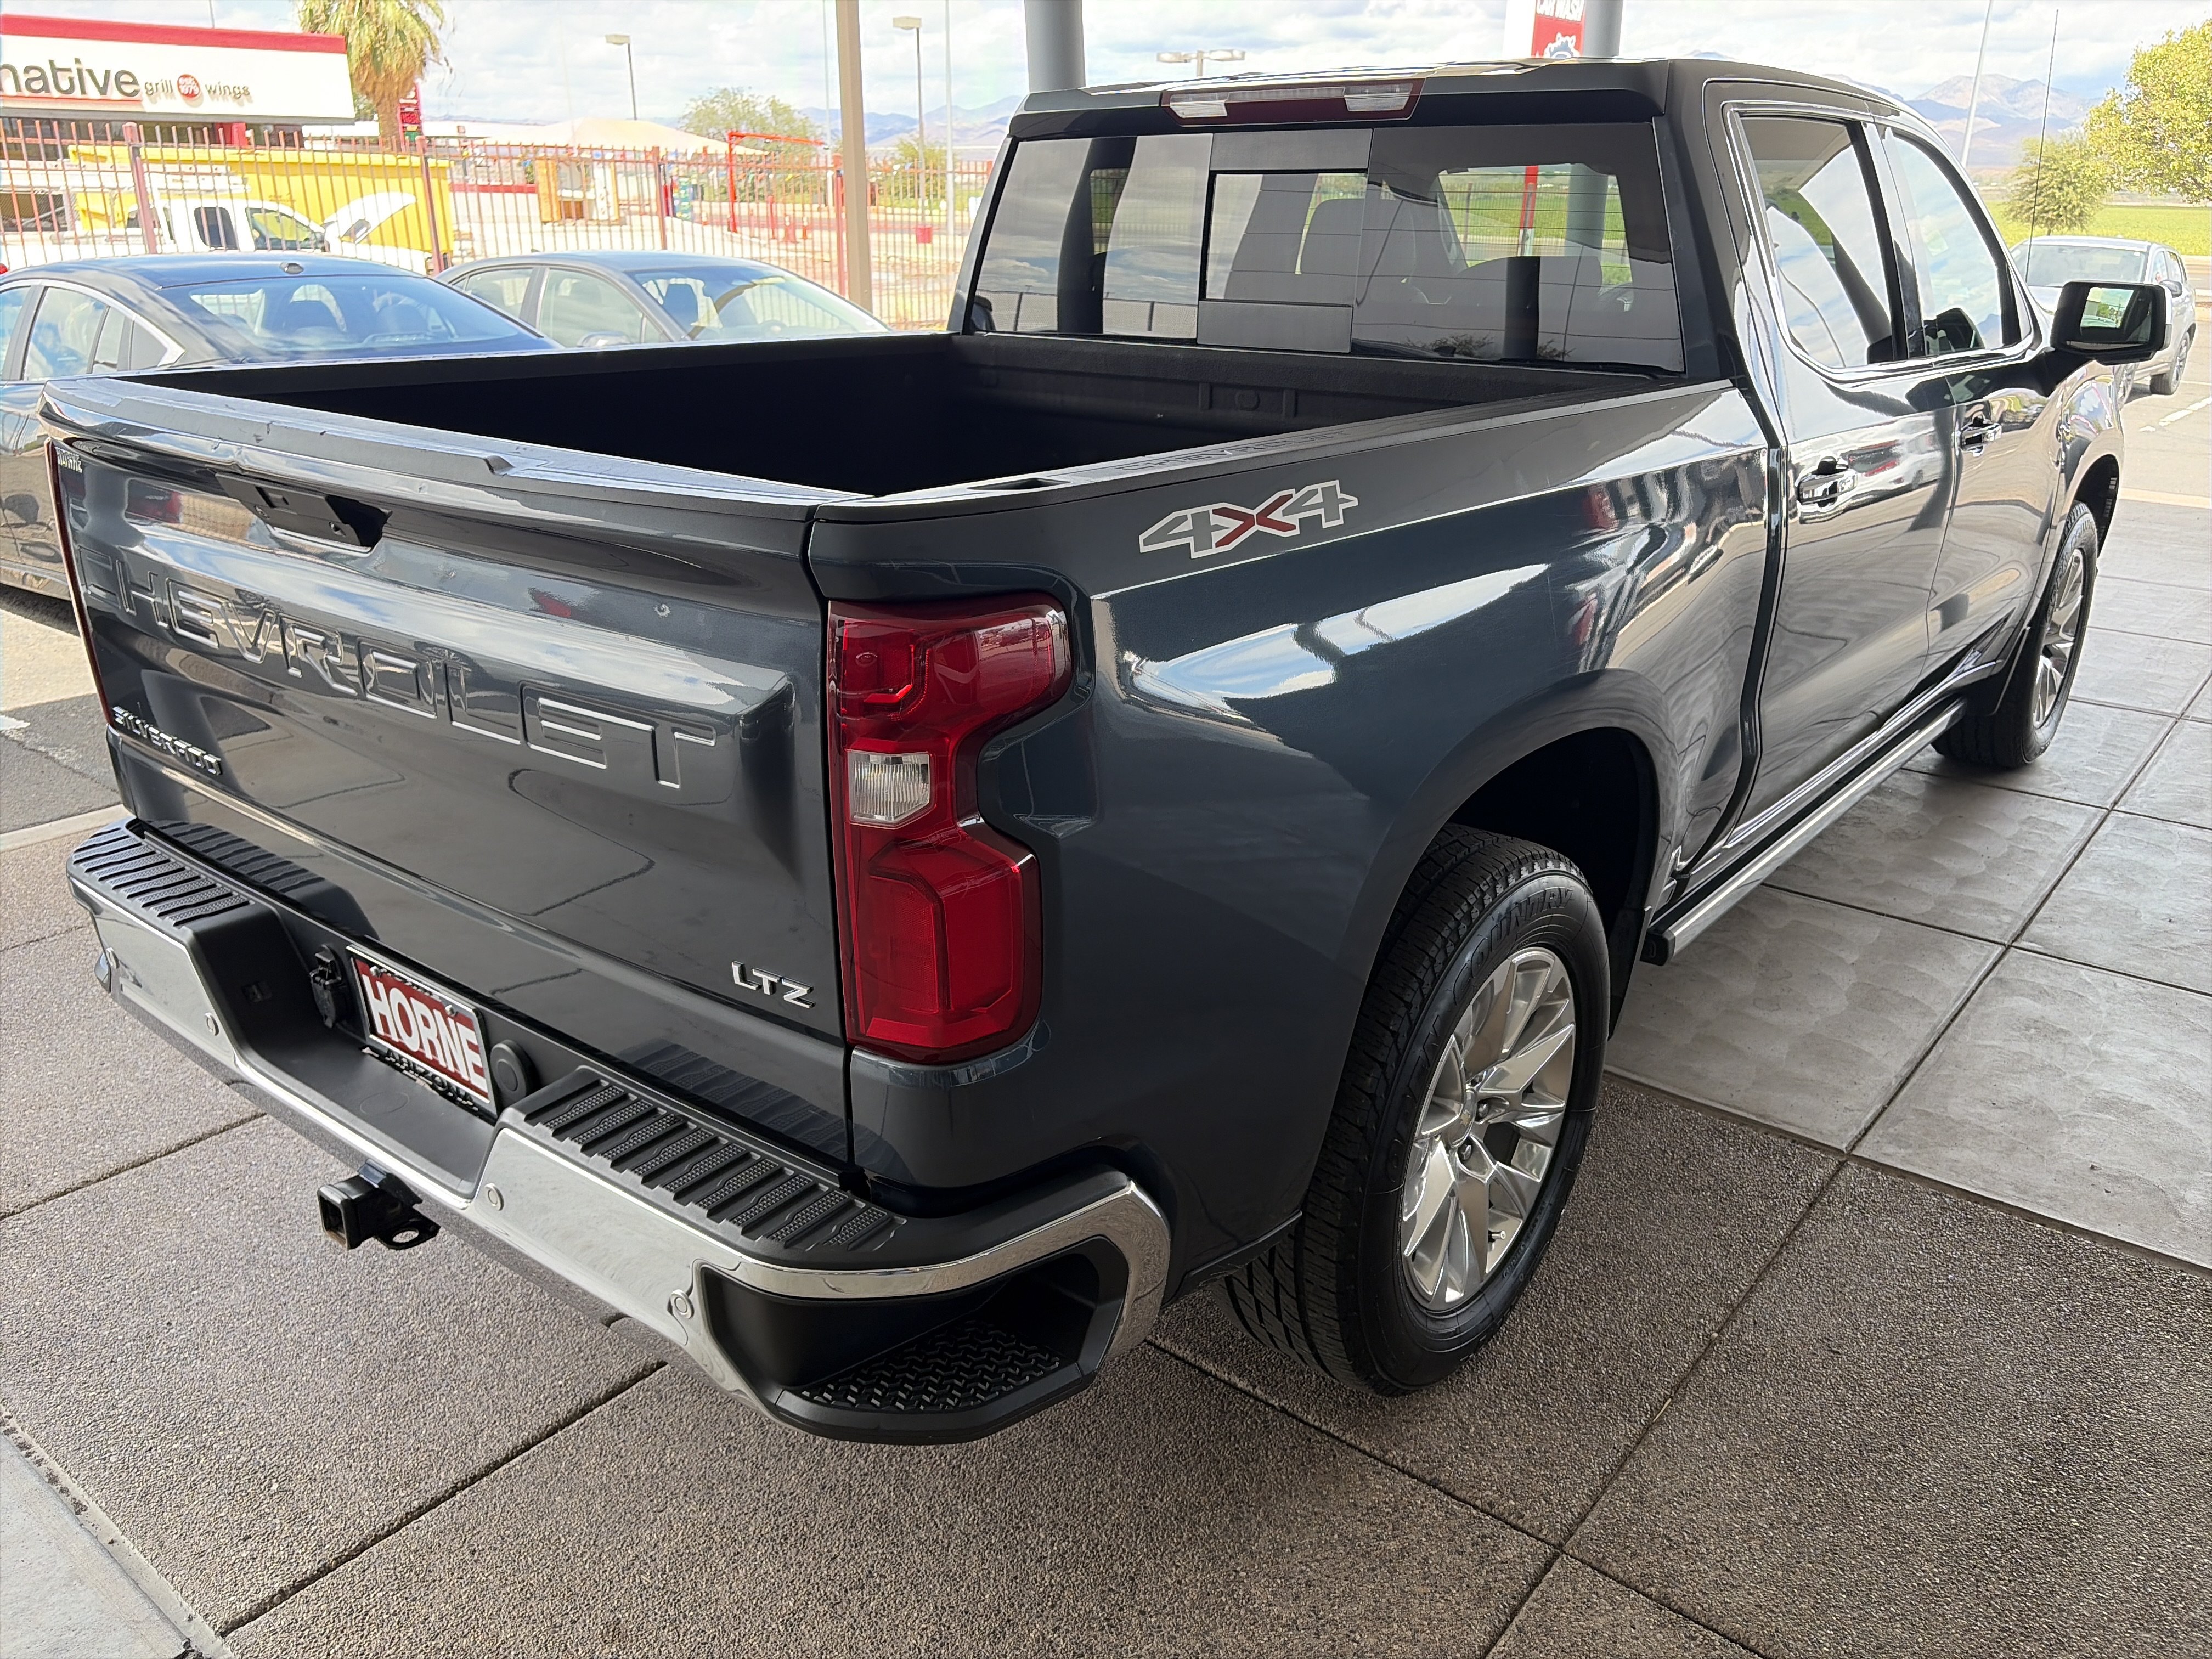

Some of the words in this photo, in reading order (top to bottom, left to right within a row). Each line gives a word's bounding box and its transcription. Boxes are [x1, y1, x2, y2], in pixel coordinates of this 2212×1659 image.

[0, 58, 140, 97] native
[145, 79, 174, 95] grill
[205, 81, 250, 99] wings
[77, 545, 716, 789] CHEVROLET
[112, 706, 222, 775] SILVERADO
[731, 961, 816, 1009] LTZ
[1453, 886, 1573, 1006] COUNTRY
[362, 974, 489, 1093] HORNE
